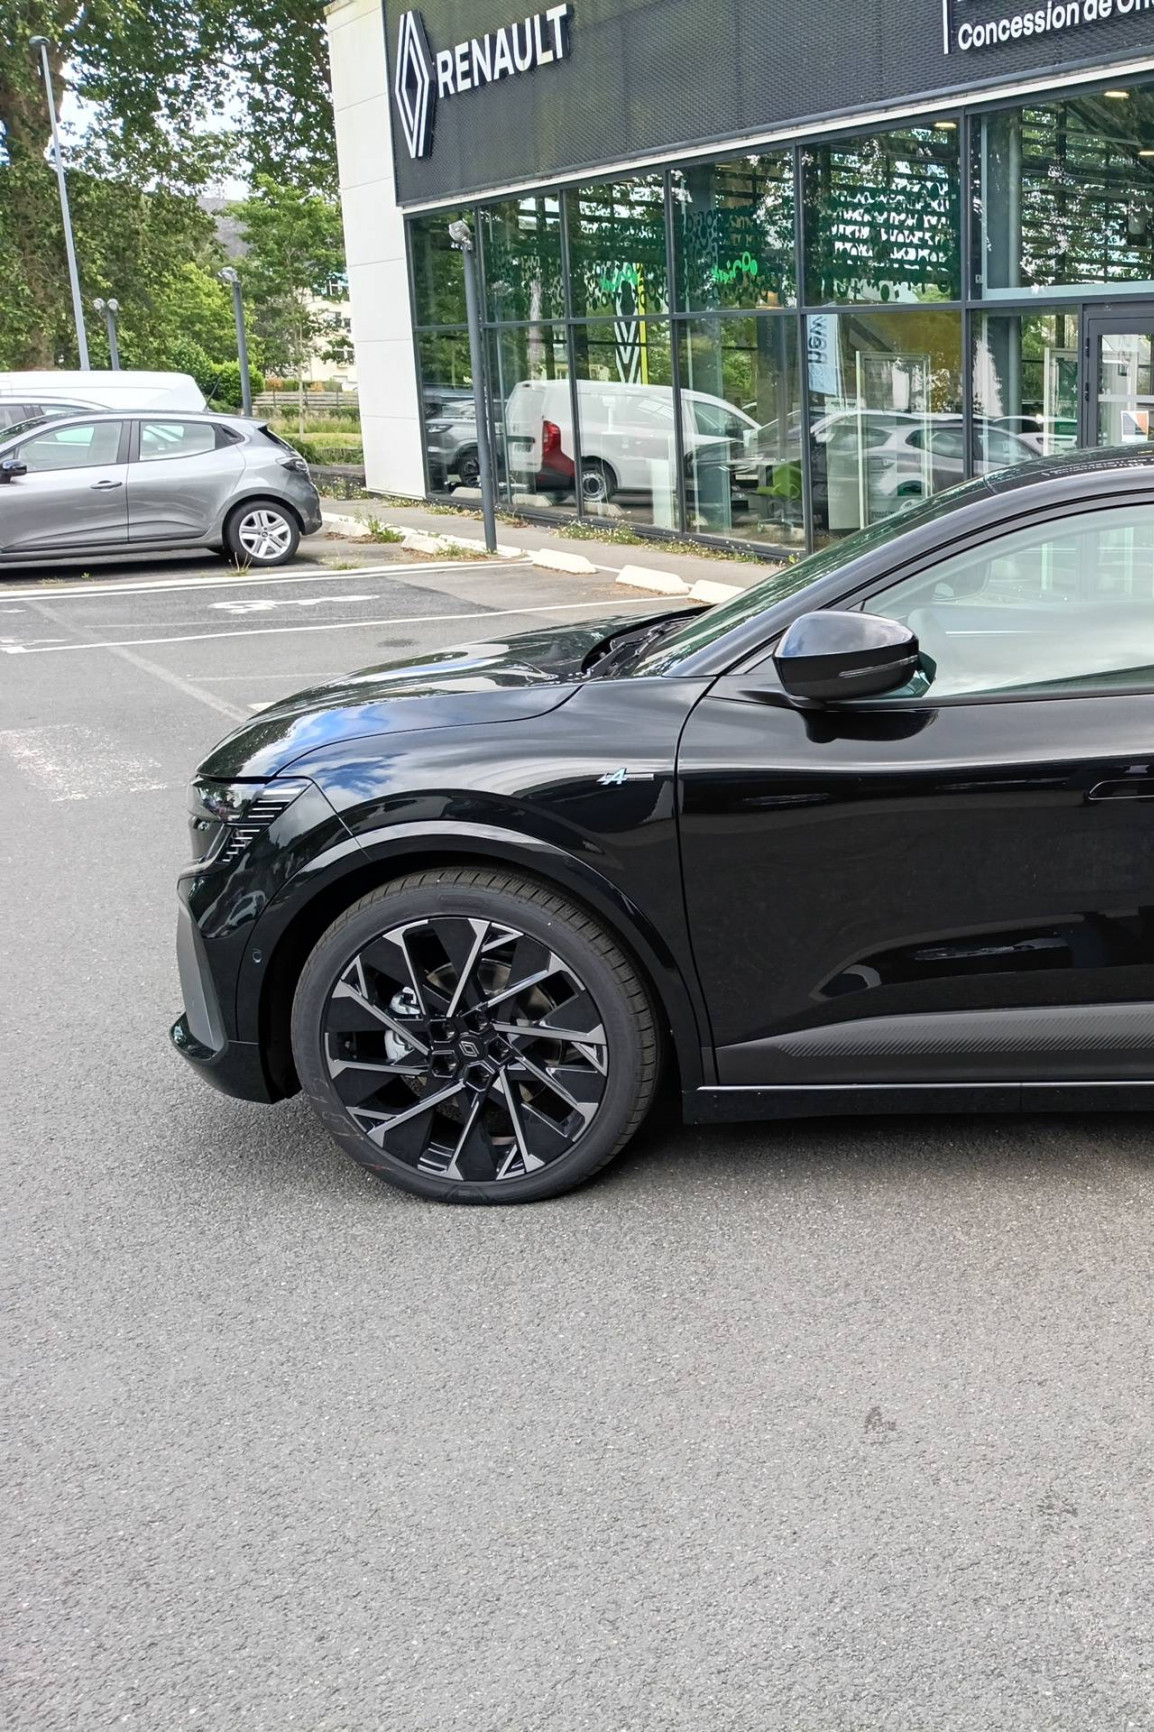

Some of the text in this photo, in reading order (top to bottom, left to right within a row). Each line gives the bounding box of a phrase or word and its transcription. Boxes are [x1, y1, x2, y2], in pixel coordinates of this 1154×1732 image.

[436, 3, 567, 99] RENAULT
[957, 0, 1113, 50] Concession de
